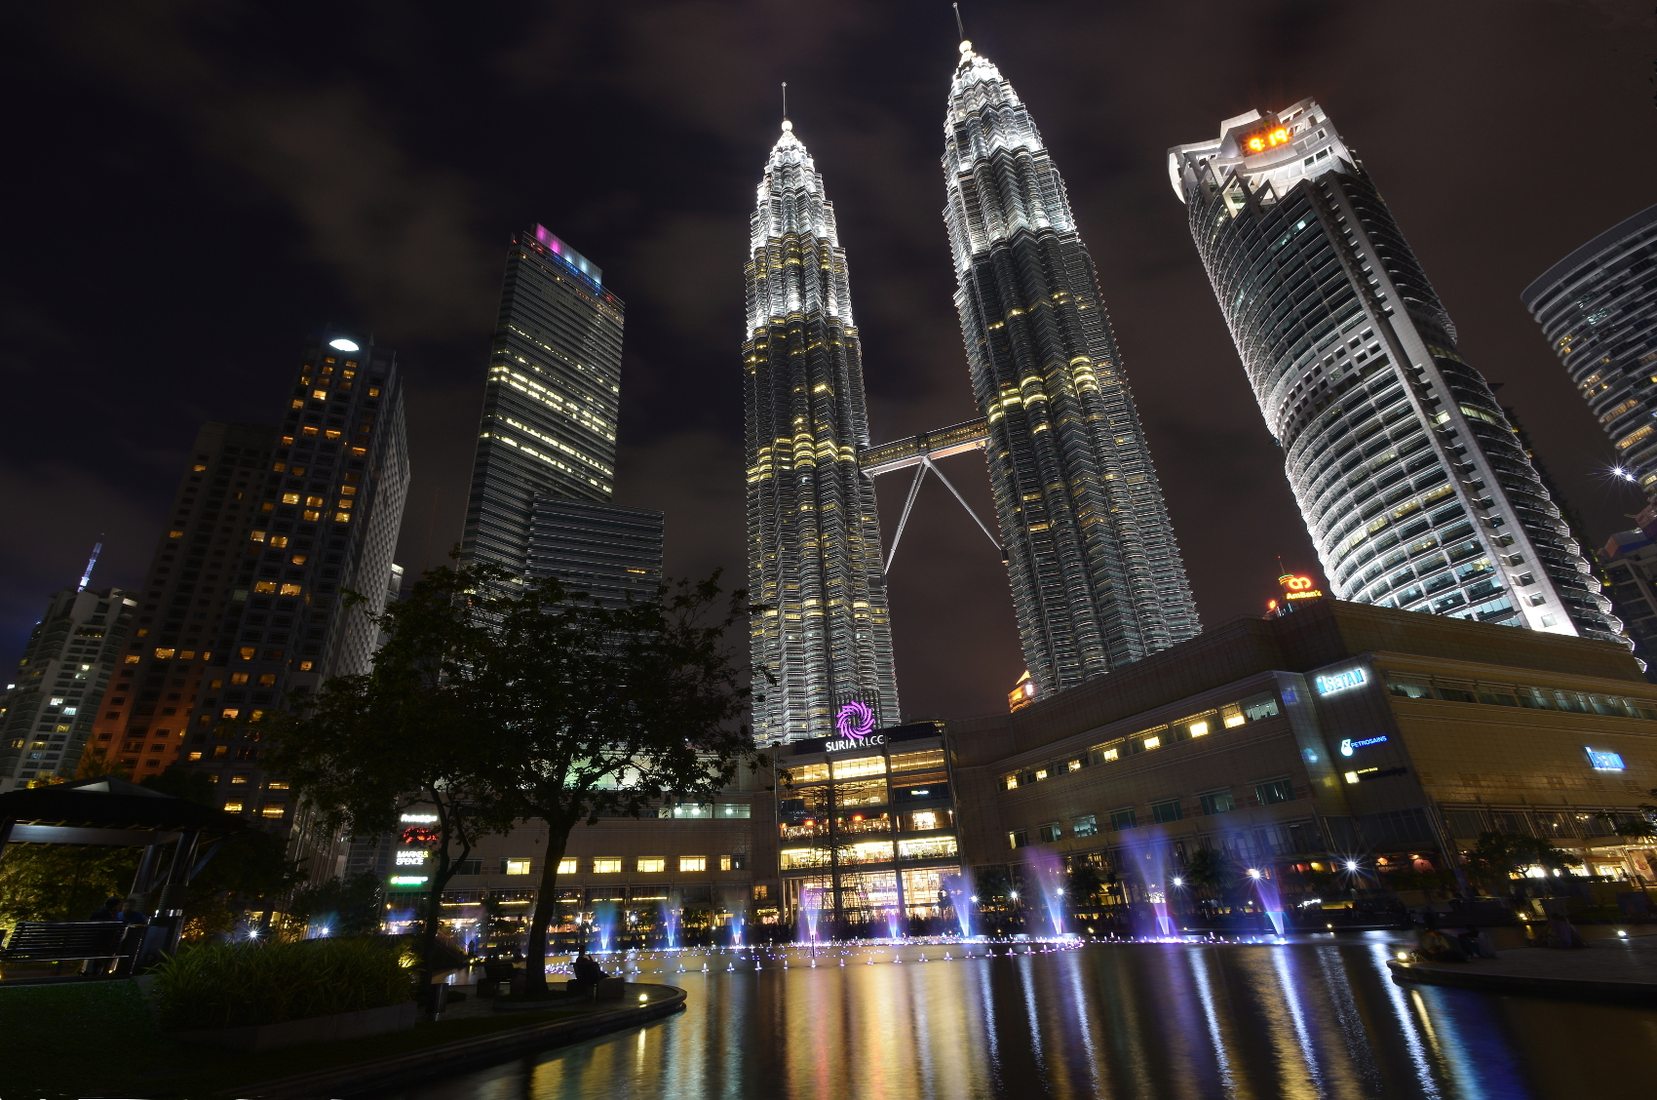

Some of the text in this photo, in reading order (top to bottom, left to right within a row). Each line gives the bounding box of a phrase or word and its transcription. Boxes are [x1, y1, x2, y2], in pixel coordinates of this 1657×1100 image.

[825, 734, 885, 752] SURIA KLCC
[1350, 735, 1388, 748] PETROSAINS
